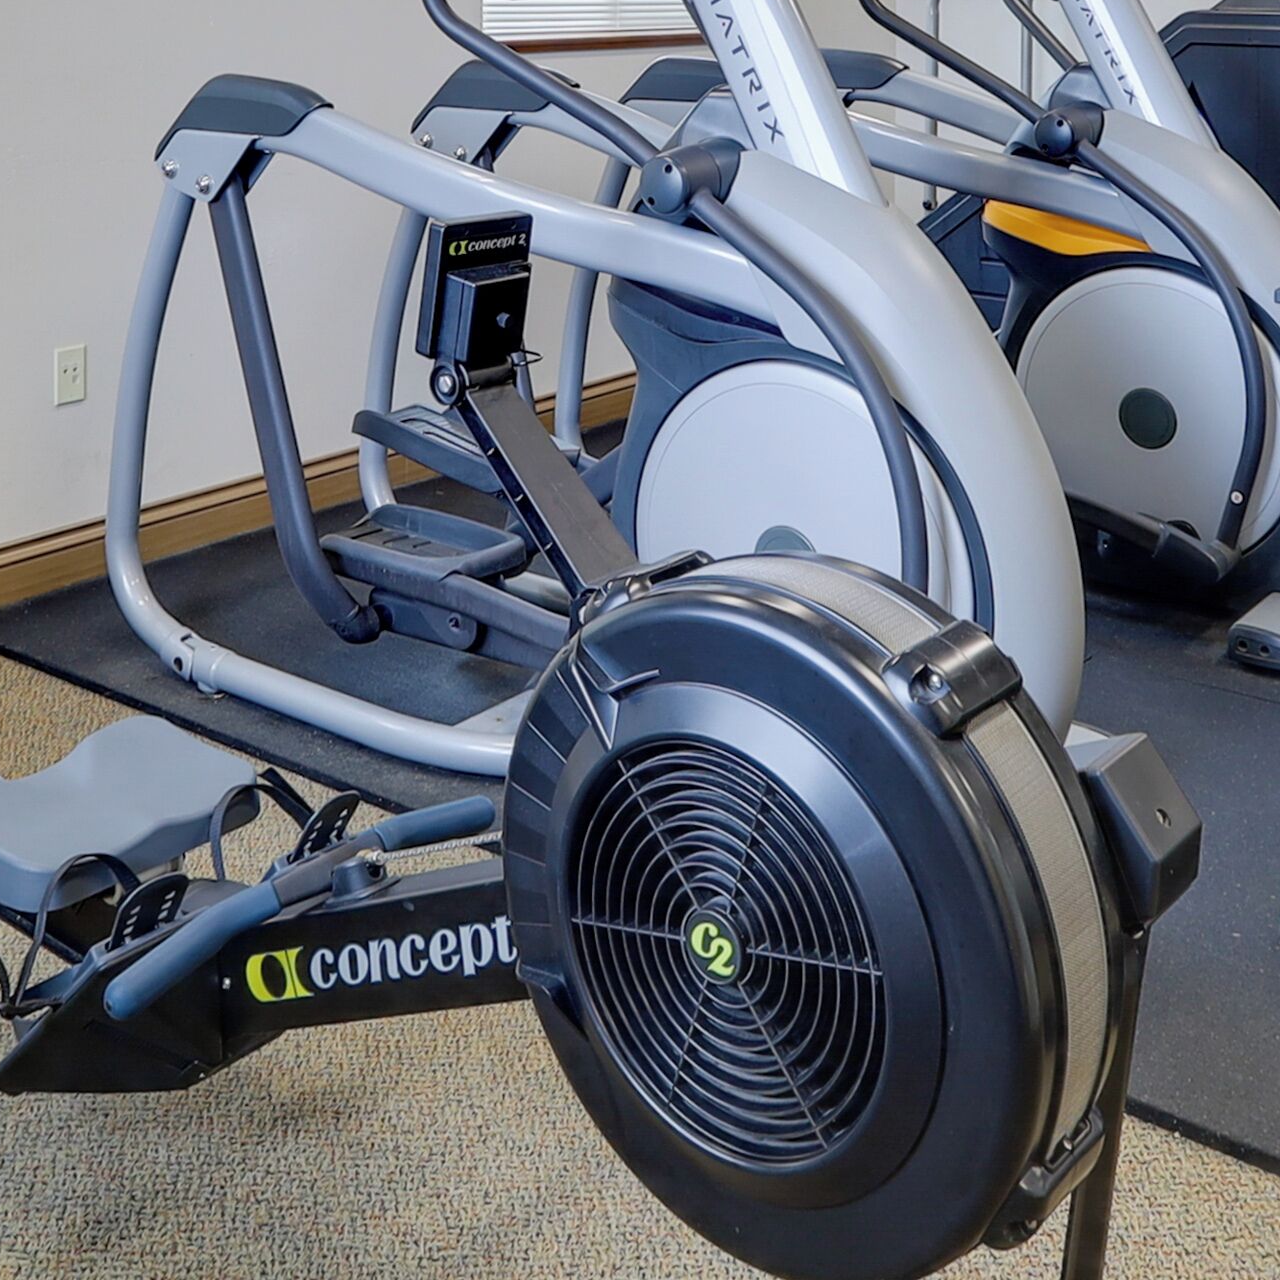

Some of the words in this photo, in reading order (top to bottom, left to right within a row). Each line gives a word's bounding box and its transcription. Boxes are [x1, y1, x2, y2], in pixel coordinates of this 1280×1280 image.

[468, 235, 517, 252] concept
[310, 915, 518, 990] concept
[691, 922, 736, 976] C2
